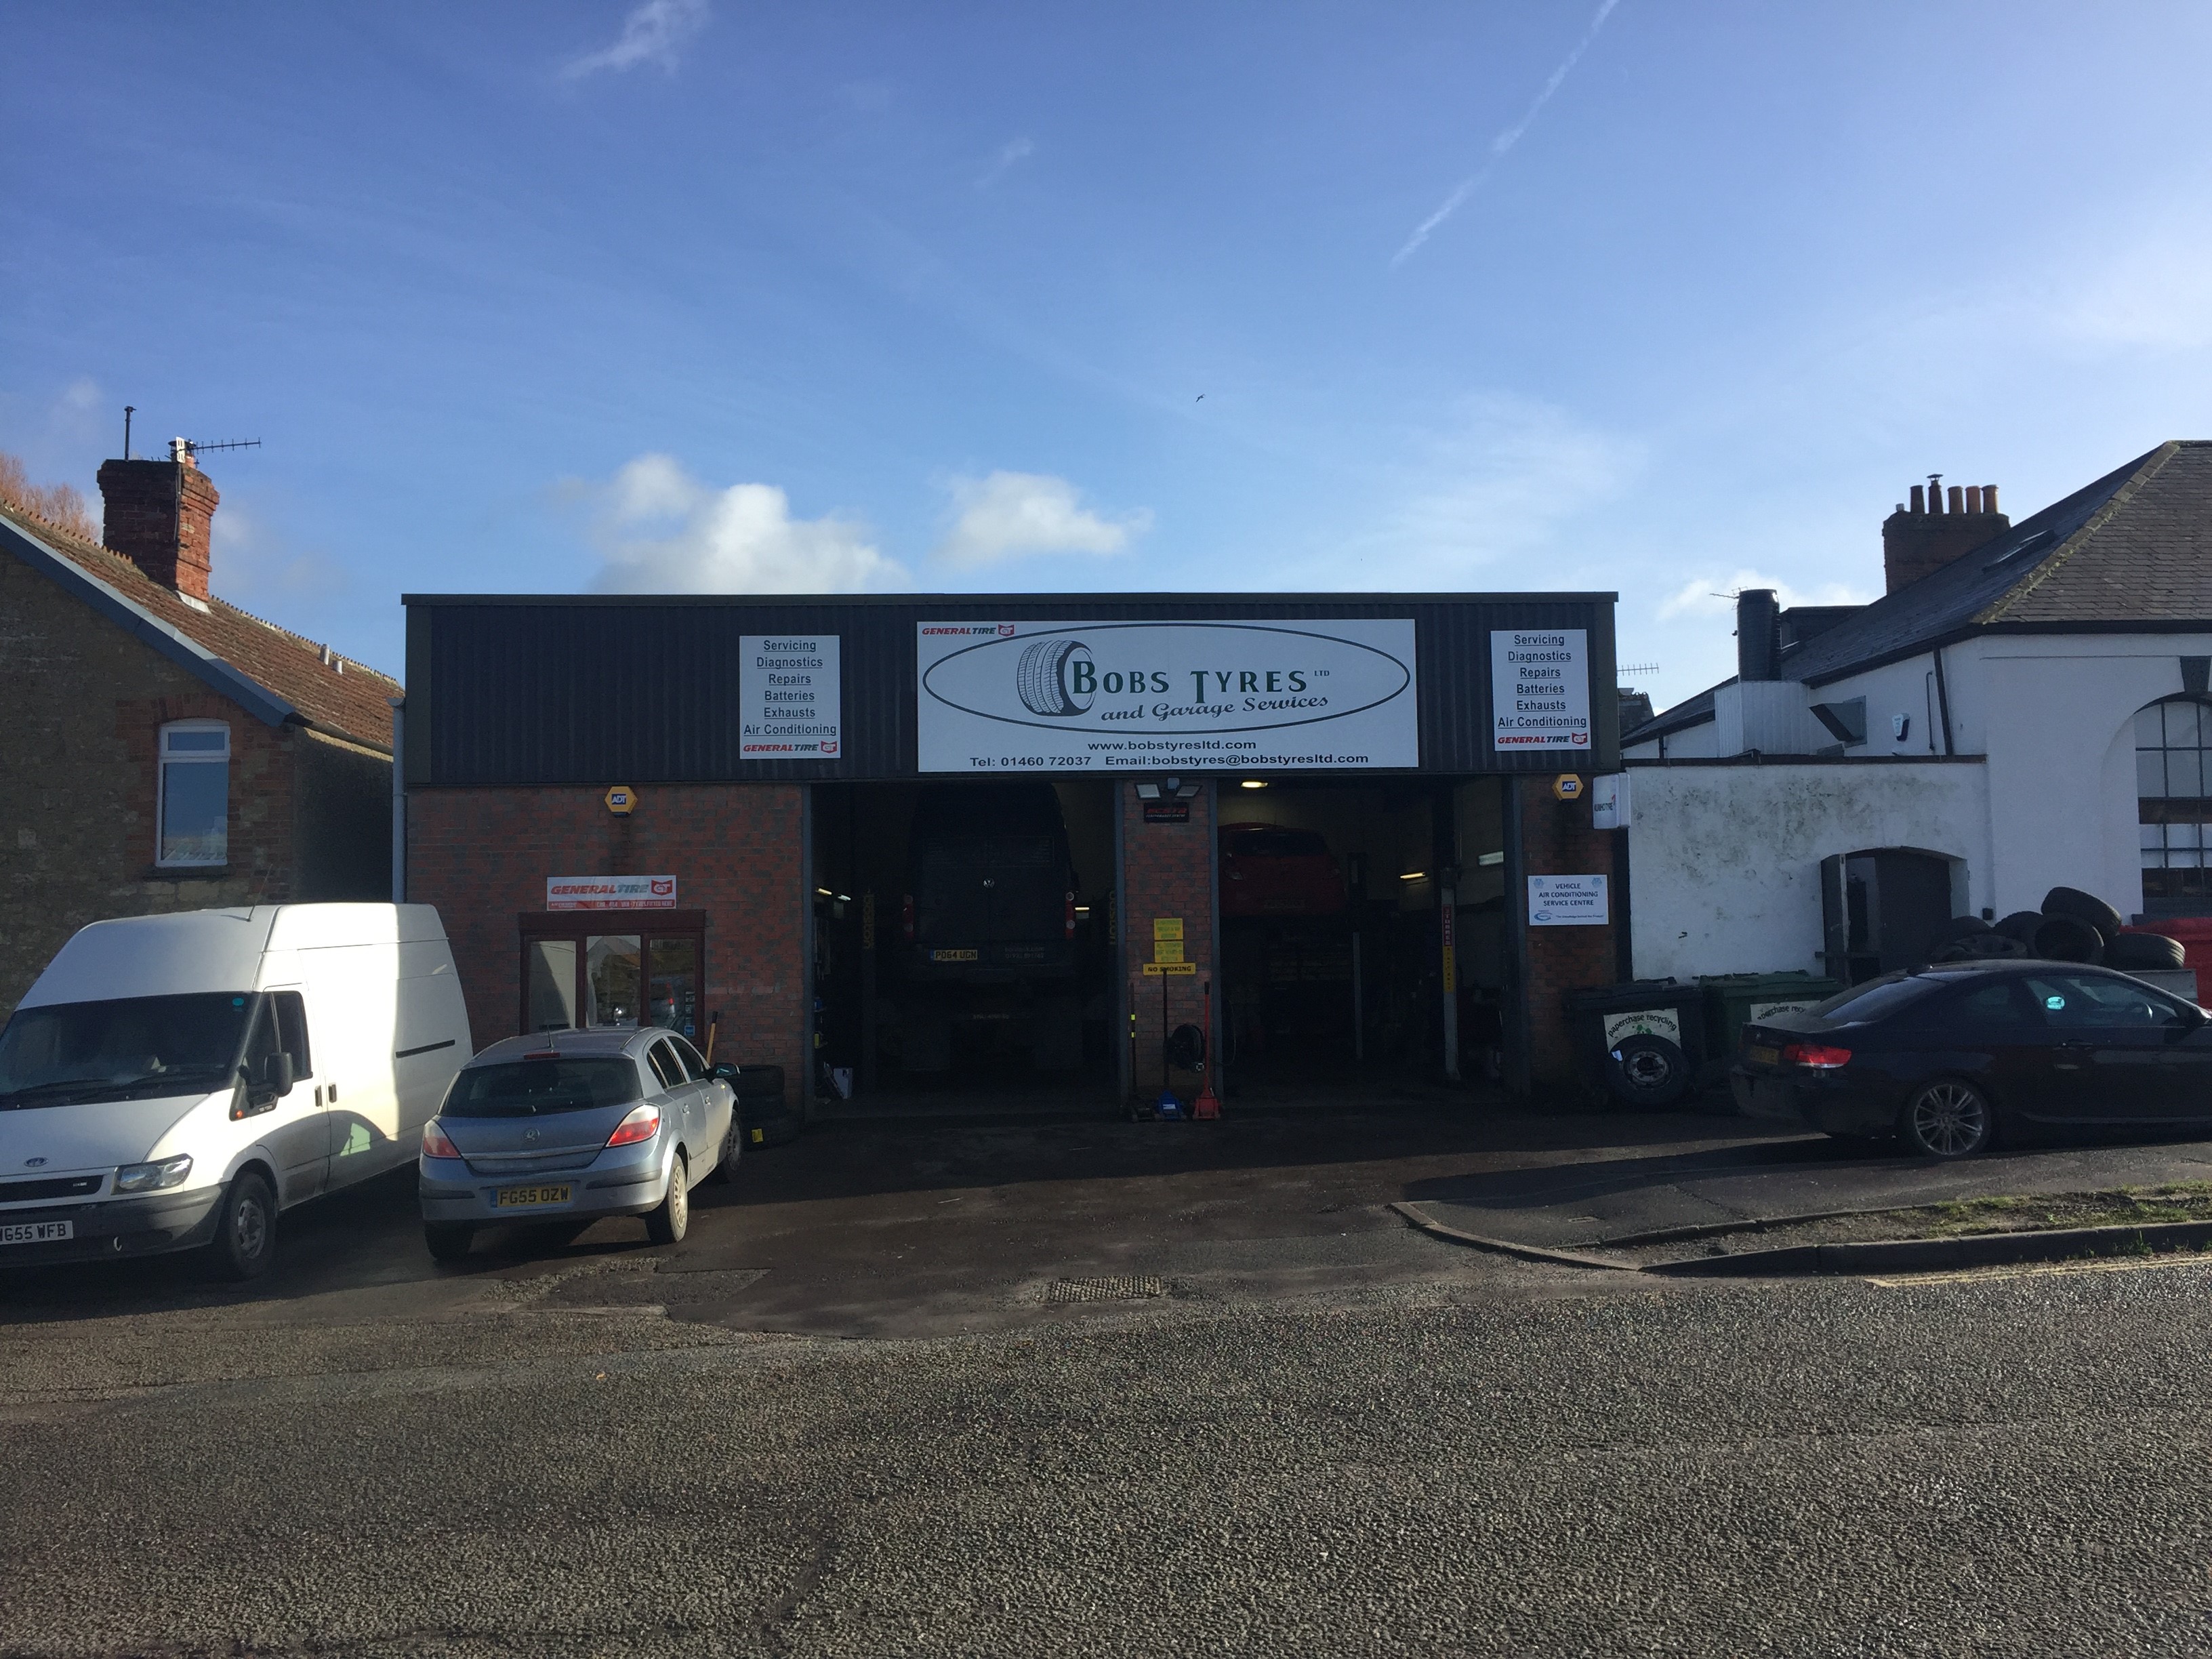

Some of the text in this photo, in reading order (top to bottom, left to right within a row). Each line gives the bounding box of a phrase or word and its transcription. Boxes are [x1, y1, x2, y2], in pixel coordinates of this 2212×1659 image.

[764, 640, 817, 652] Servicing
[1514, 634, 1565, 647] Servicing
[756, 657, 823, 669] Diagnostics
[1508, 651, 1572, 663] Diagnostics
[1519, 667, 1561, 678] Repairs
[769, 674, 811, 686] Repairs
[1072, 661, 1170, 695] BOBS
[1189, 670, 1307, 704] TYRES
[1517, 683, 1565, 693] Batteries
[764, 691, 815, 701] Batteries
[1101, 696, 1328, 722] and Garage Services
[1517, 700, 1566, 710] Exhausts
[764, 707, 815, 717] Exhausts
[1498, 716, 1586, 728] Air Conditioning
[743, 724, 837, 736] Air Conditioning
[1087, 740, 1256, 752] www.bobstyresltd.com
[970, 757, 996, 766] Tel:
[1000, 757, 1044, 766] 01460
[1048, 756, 1092, 766] 72037
[1562, 781, 1576, 791] ADT
[612, 794, 626, 804] ADT
[1607, 1015, 1677, 1038] paperchase recycling
[499, 1189, 537, 1206] FG55
[37, 1223, 66, 1239] WFB
